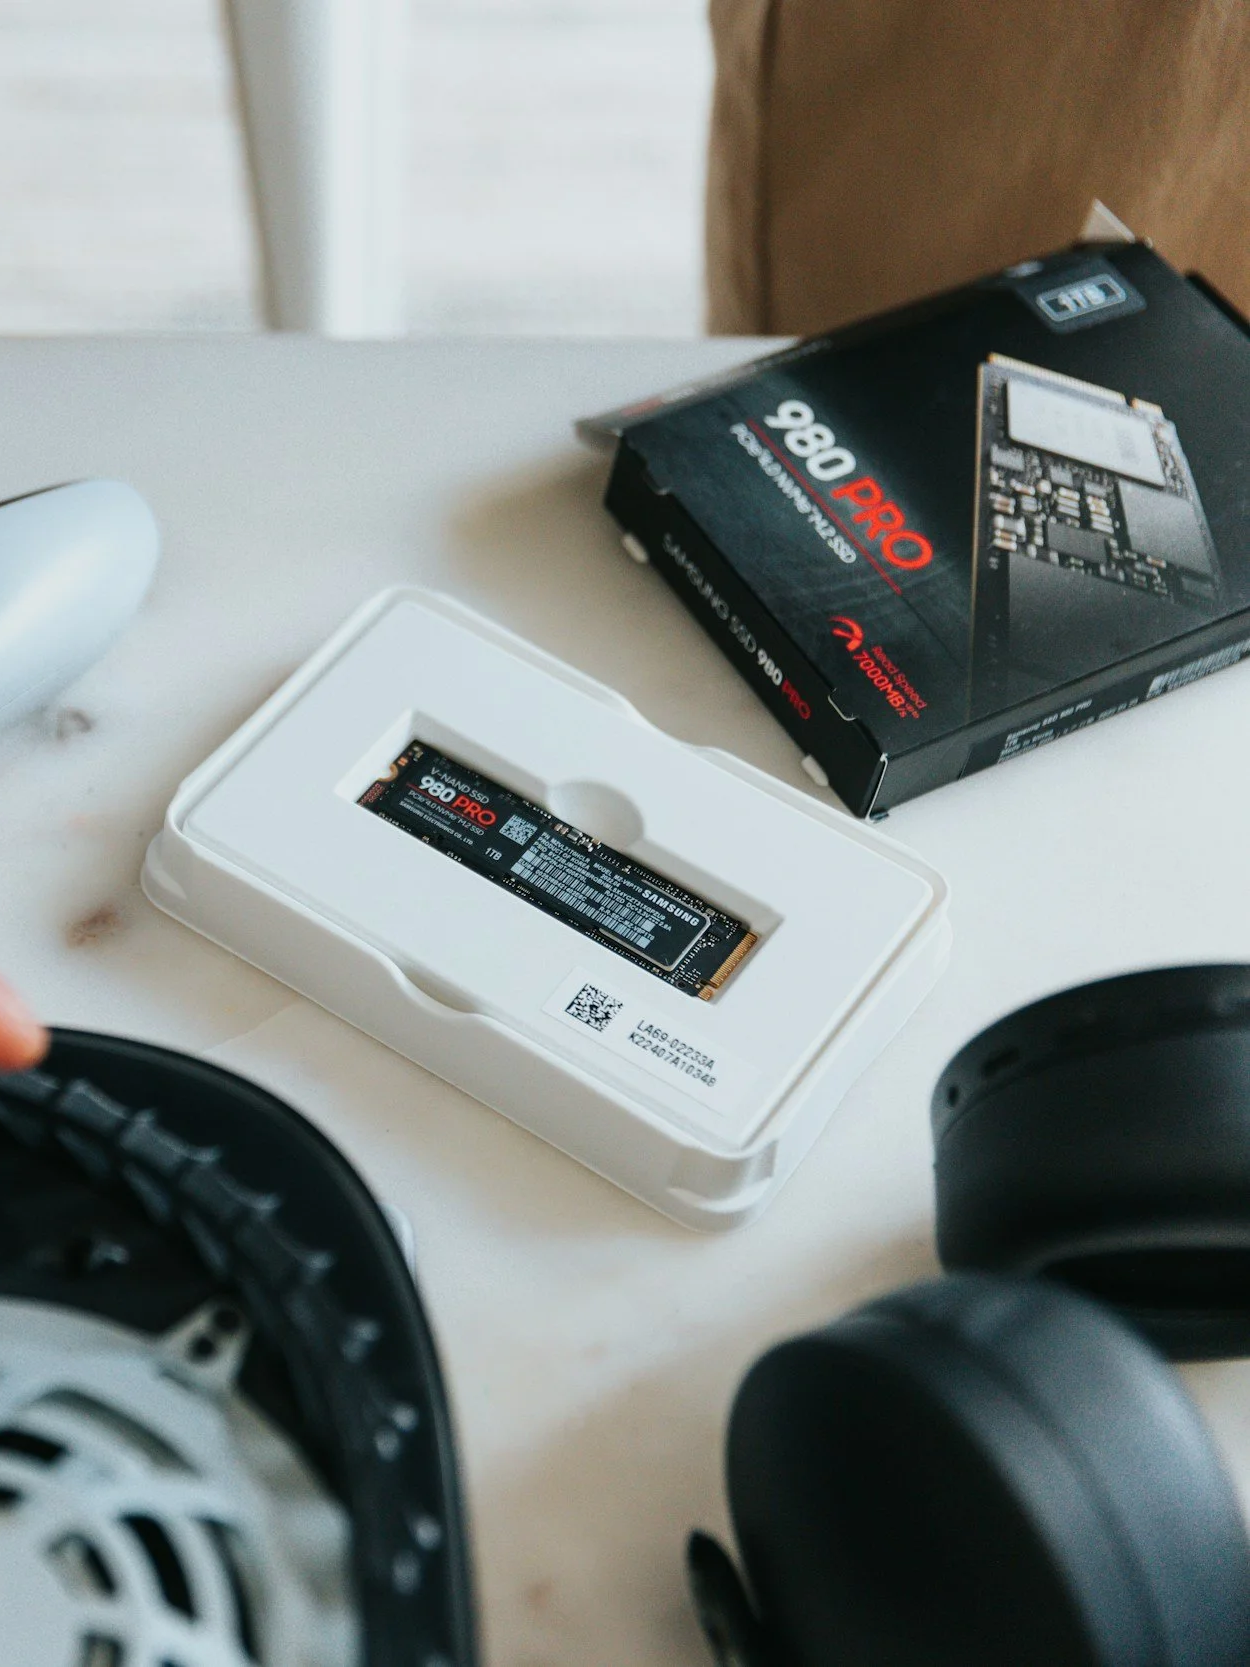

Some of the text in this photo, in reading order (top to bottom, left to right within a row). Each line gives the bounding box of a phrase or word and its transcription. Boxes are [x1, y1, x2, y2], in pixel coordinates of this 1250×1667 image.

[764, 399, 934, 571] 980 PRO
[828, 536, 856, 563] SSD
[662, 533, 811, 720] SAMSUNG SSD 980 PRO
[872, 646, 927, 709] Read Speed
[420, 776, 496, 825] 980 PRO
[431, 767, 489, 804] V-NAND SSD
[399, 801, 424, 817] SAMSUNG
[423, 815, 454, 834] ELECTRONICS
[426, 801, 436, 809] 4.0
[458, 818, 470, 828] M.2
[470, 826, 484, 836] SSD
[484, 846, 502, 861] 1TB
[537, 837, 562, 854] PRODUCT
[571, 858, 589, 870] KOREA
[593, 863, 613, 876] MODEL
[605, 890, 624, 903] RATED
[642, 890, 699, 926] SAMSUNG
[637, 1020, 714, 1070] LA69-02233A
